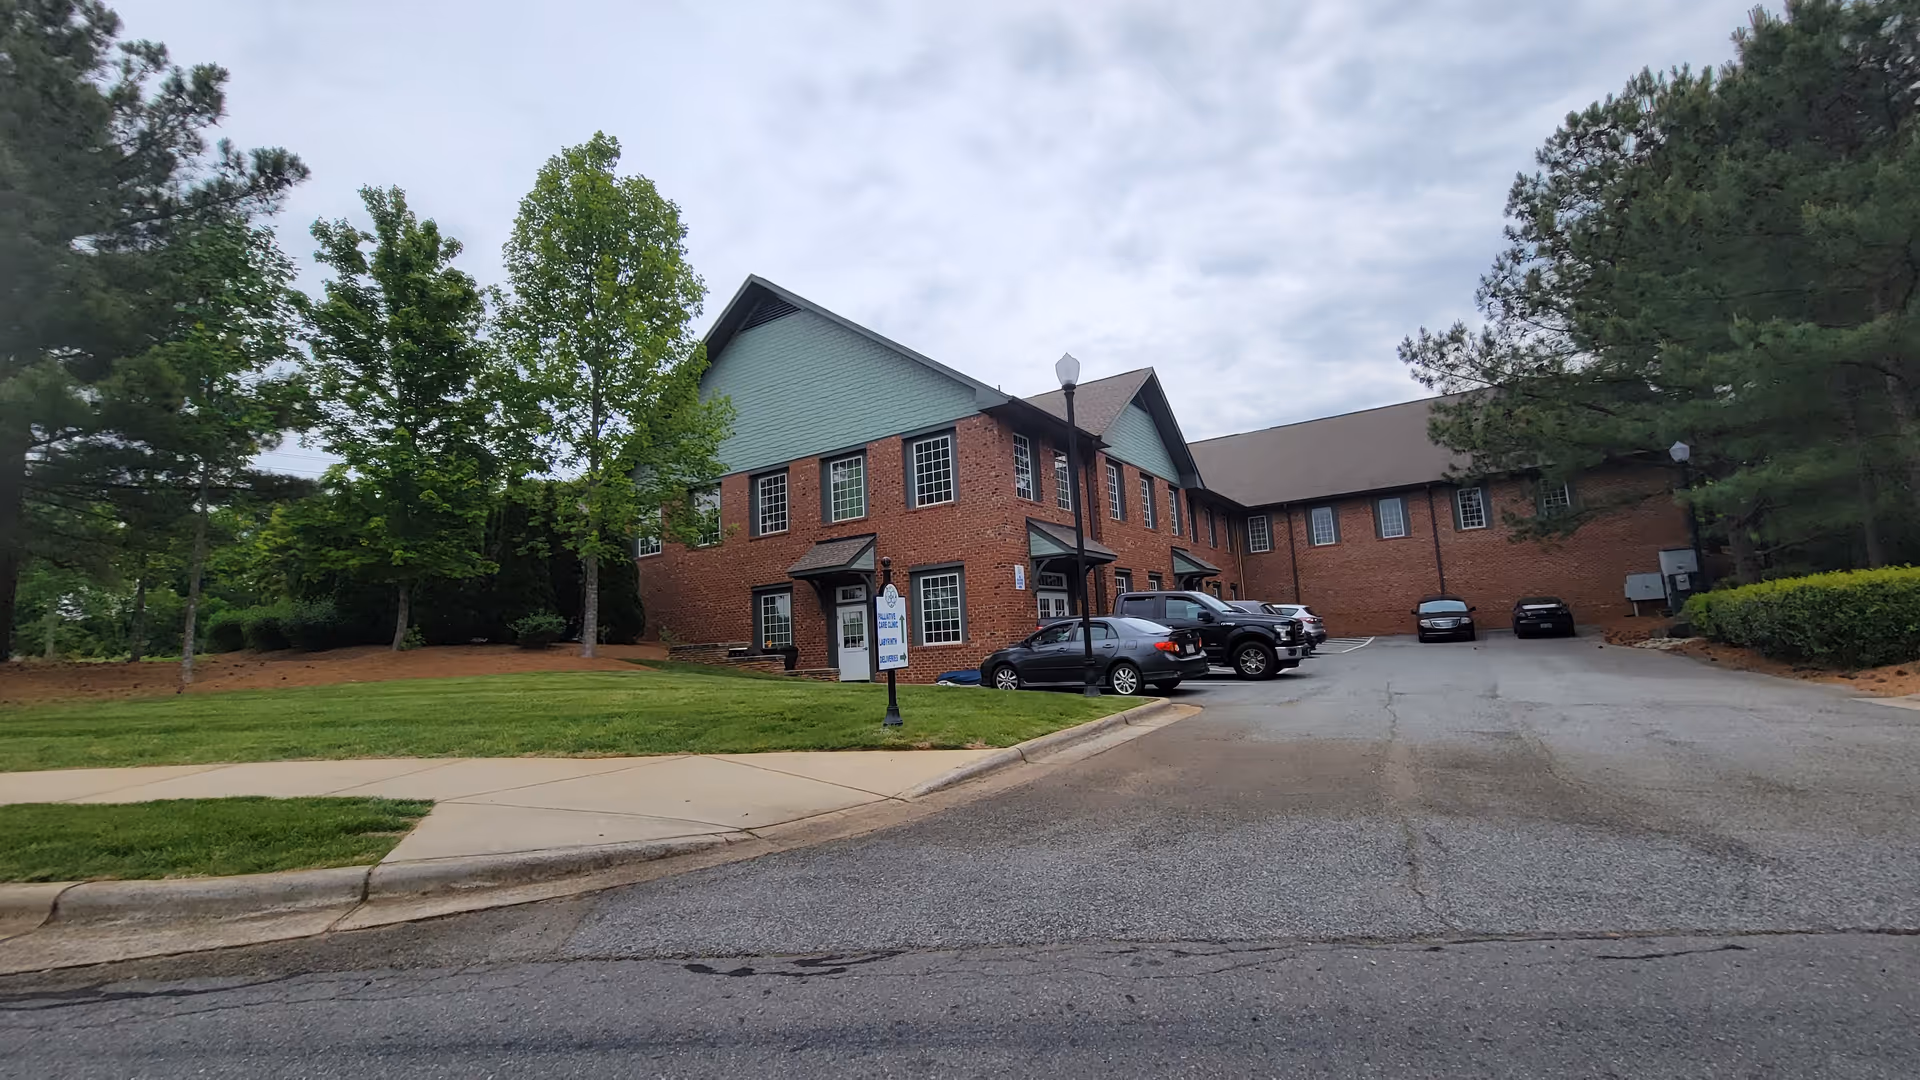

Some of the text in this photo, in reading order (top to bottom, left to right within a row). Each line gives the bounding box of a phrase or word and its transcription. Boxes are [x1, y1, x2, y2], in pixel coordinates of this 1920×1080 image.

[879, 621, 887, 629] CARE
[879, 638, 897, 646] LABYRINTH
[880, 654, 898, 663] DELIVERIES
